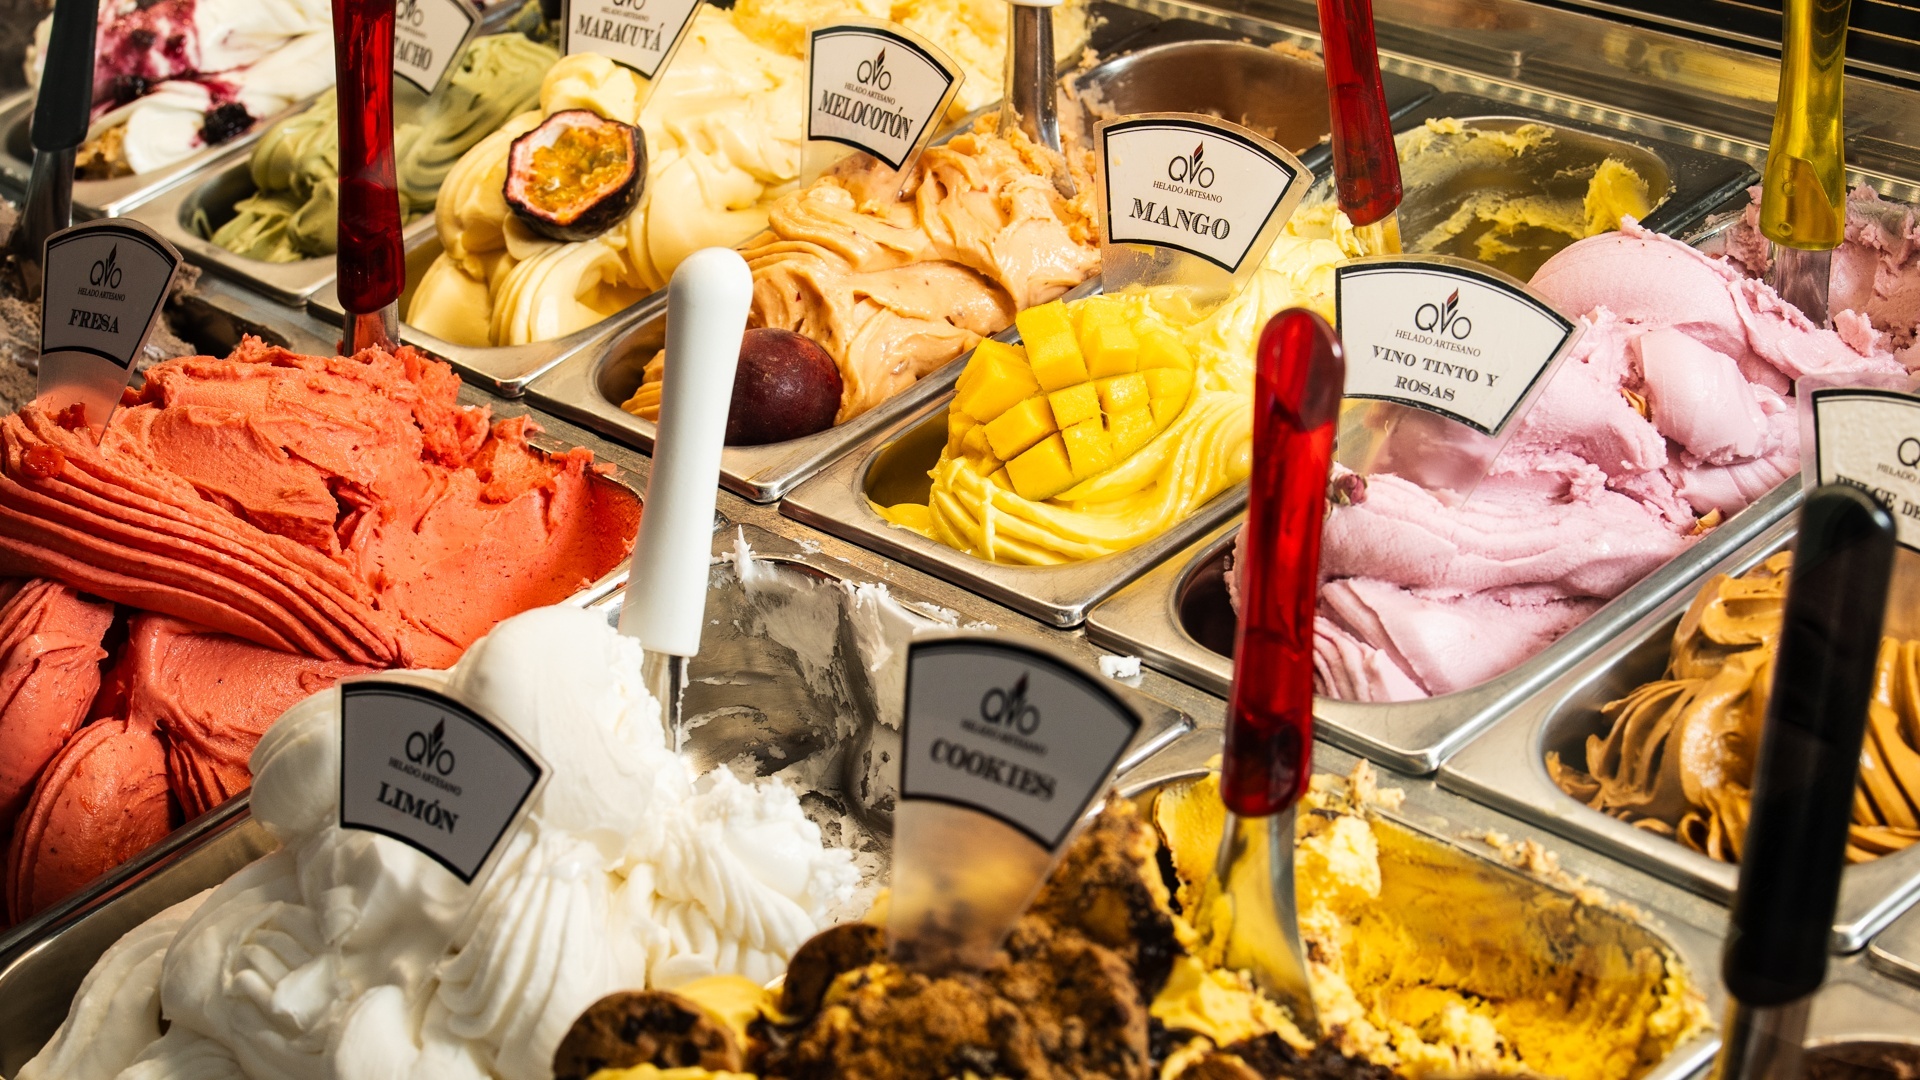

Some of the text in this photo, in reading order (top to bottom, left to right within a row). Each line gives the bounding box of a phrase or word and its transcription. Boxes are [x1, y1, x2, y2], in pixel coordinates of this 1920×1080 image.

[575, 14, 665, 52] MARACUYÁ
[857, 59, 892, 91] QVO
[844, 82, 896, 106] HELADO ARTESANO
[818, 90, 914, 142] MELOCOTÓN
[1168, 154, 1215, 189] QVO
[1152, 180, 1223, 204] HELADO ARTESANO
[1128, 198, 1231, 240] MANGO
[90, 257, 122, 289] QVO
[77, 287, 126, 302] HELADO ARTESANO
[68, 308, 120, 334] FRESA
[1414, 302, 1472, 340] QVO
[1395, 329, 1481, 357] HELADO ARTESANO
[1372, 345, 1500, 388] VINO TINTO Y
[1394, 375, 1456, 402] ROSAS
[1876, 462, 1917, 483] HELADO
[405, 731, 455, 776] QVO
[929, 737, 1058, 800] COOKIES
[376, 780, 460, 834] LIMÓN
